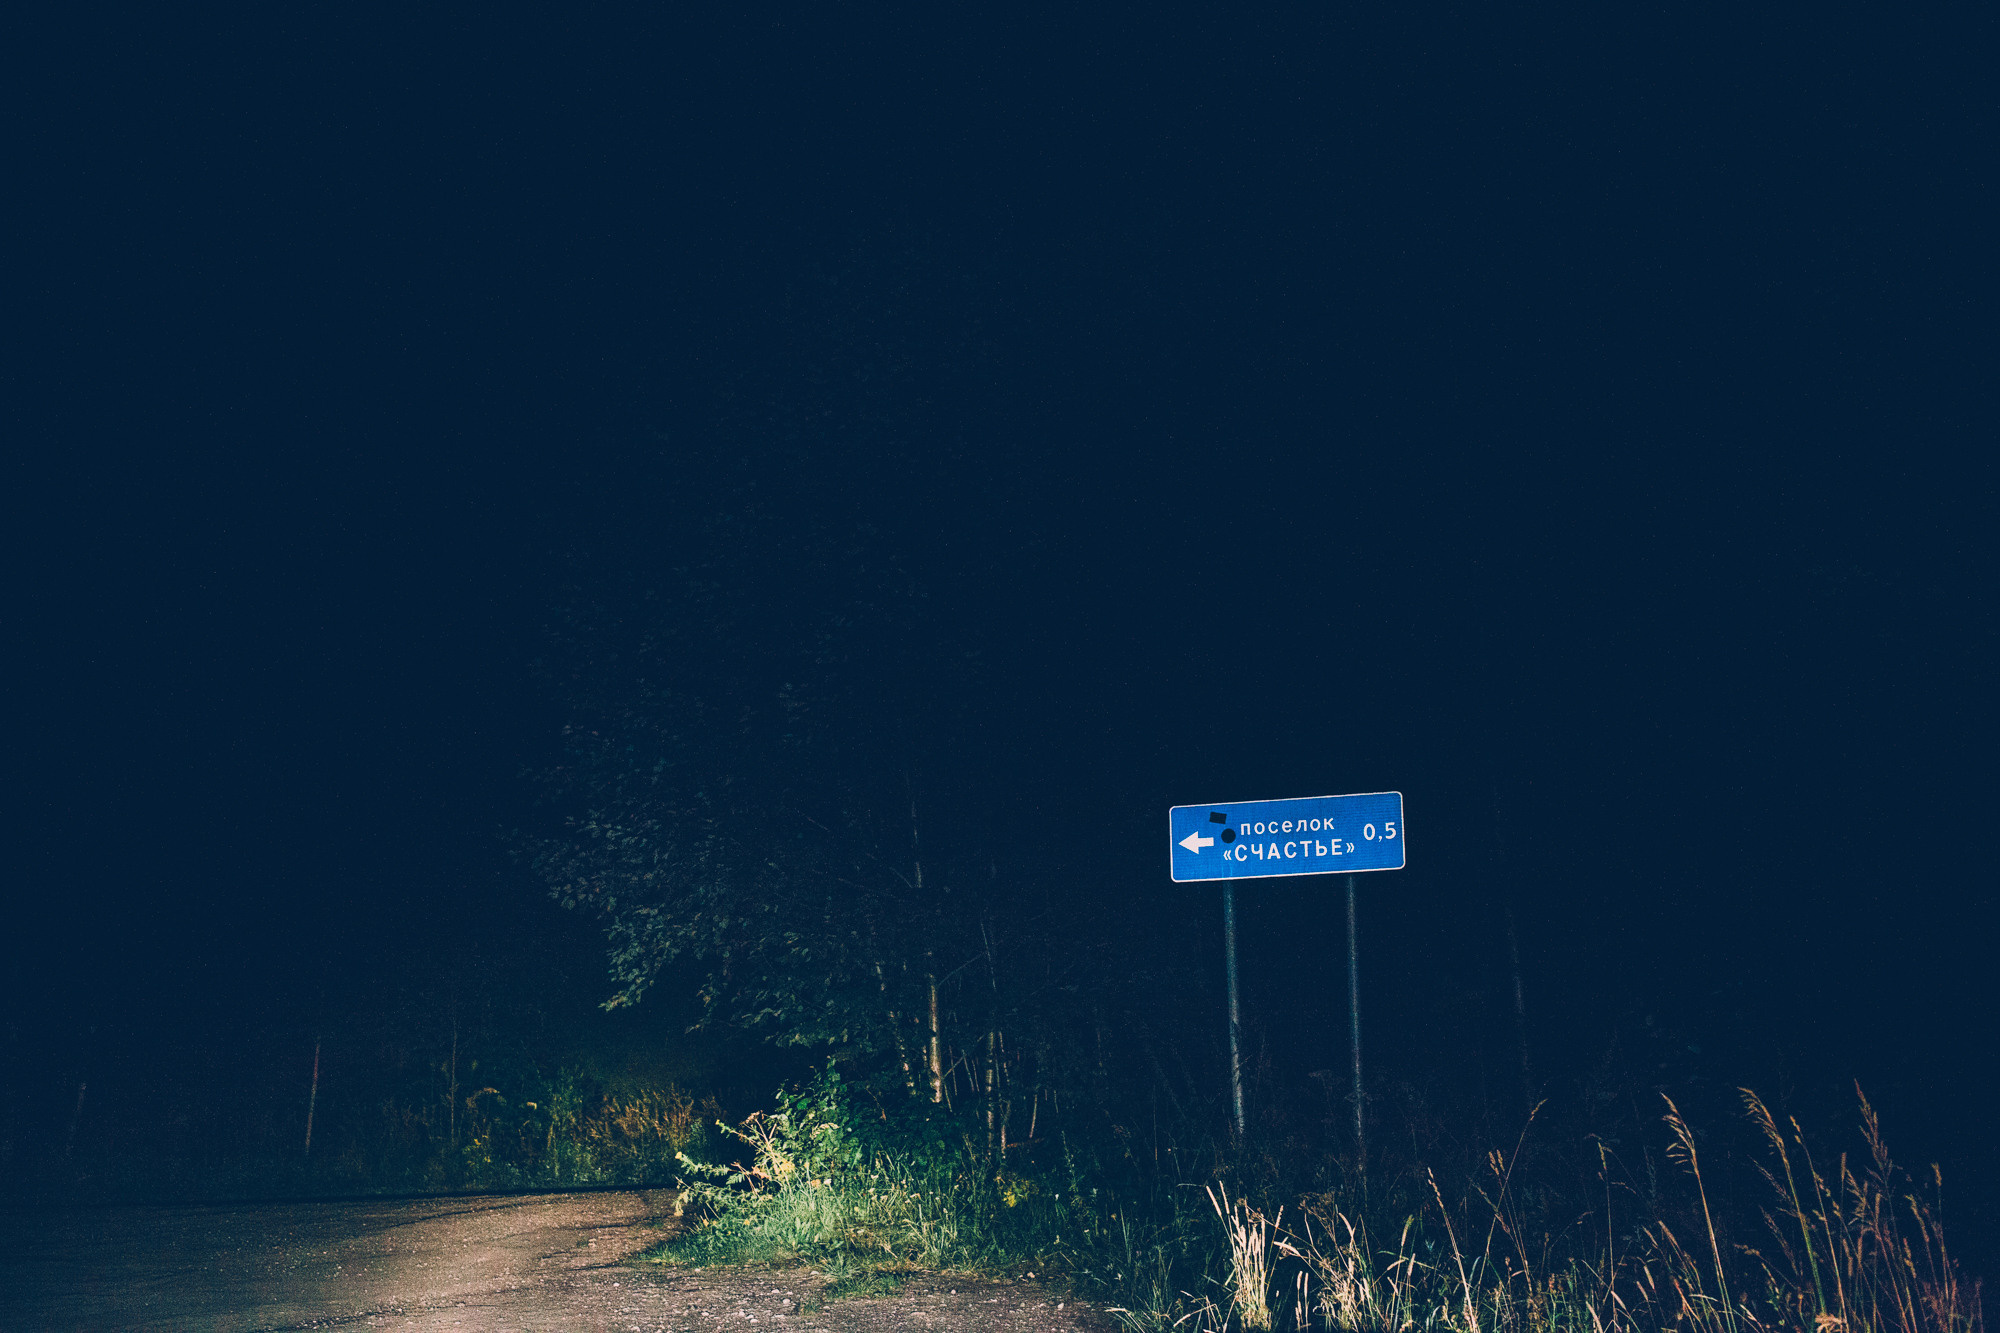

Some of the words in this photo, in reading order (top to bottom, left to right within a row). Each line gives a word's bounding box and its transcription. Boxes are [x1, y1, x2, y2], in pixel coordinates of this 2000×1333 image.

[1240, 817, 1335, 836] поселок
[1363, 821, 1397, 843] 0,5
[1223, 838, 1355, 862] «СЧАСТЬЕ»
